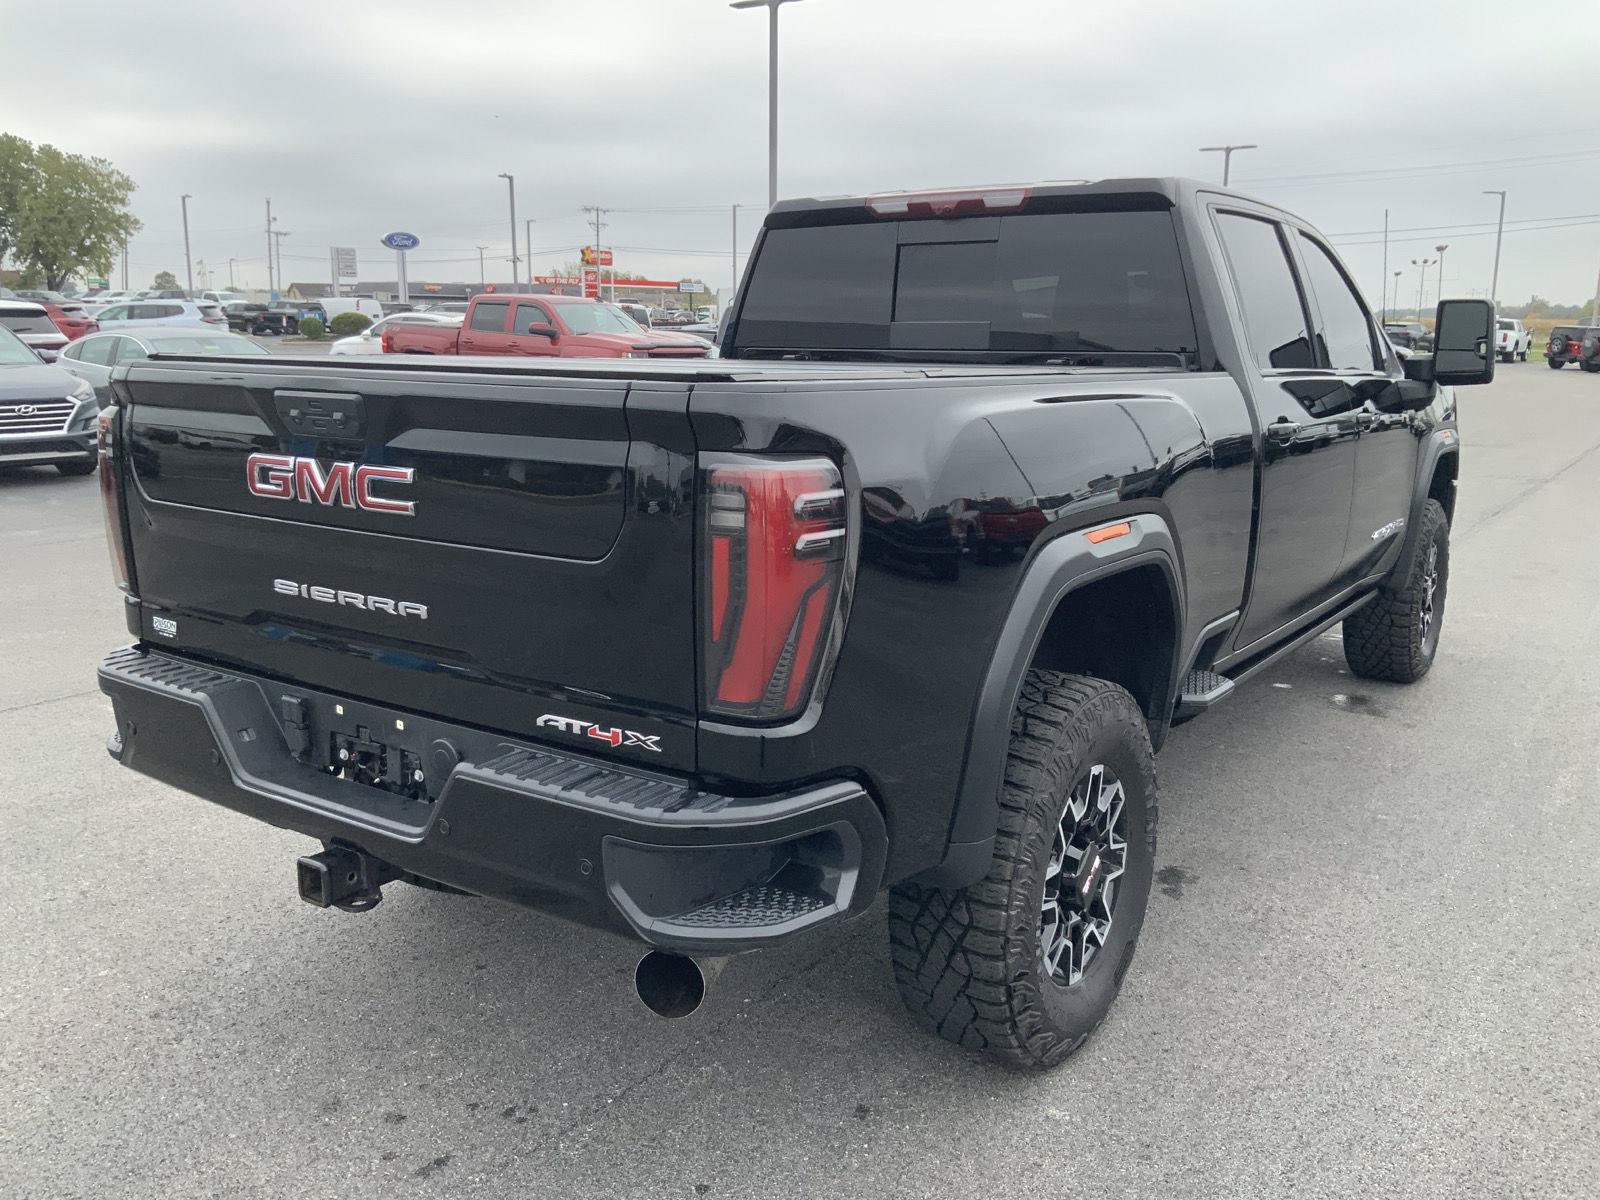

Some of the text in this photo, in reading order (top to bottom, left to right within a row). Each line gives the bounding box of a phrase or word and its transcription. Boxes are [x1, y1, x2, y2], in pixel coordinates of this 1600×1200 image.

[392, 234, 413, 247] Ford
[246, 451, 418, 516] GMC
[273, 578, 429, 620] SIERRA
[536, 713, 663, 752] AT4X
